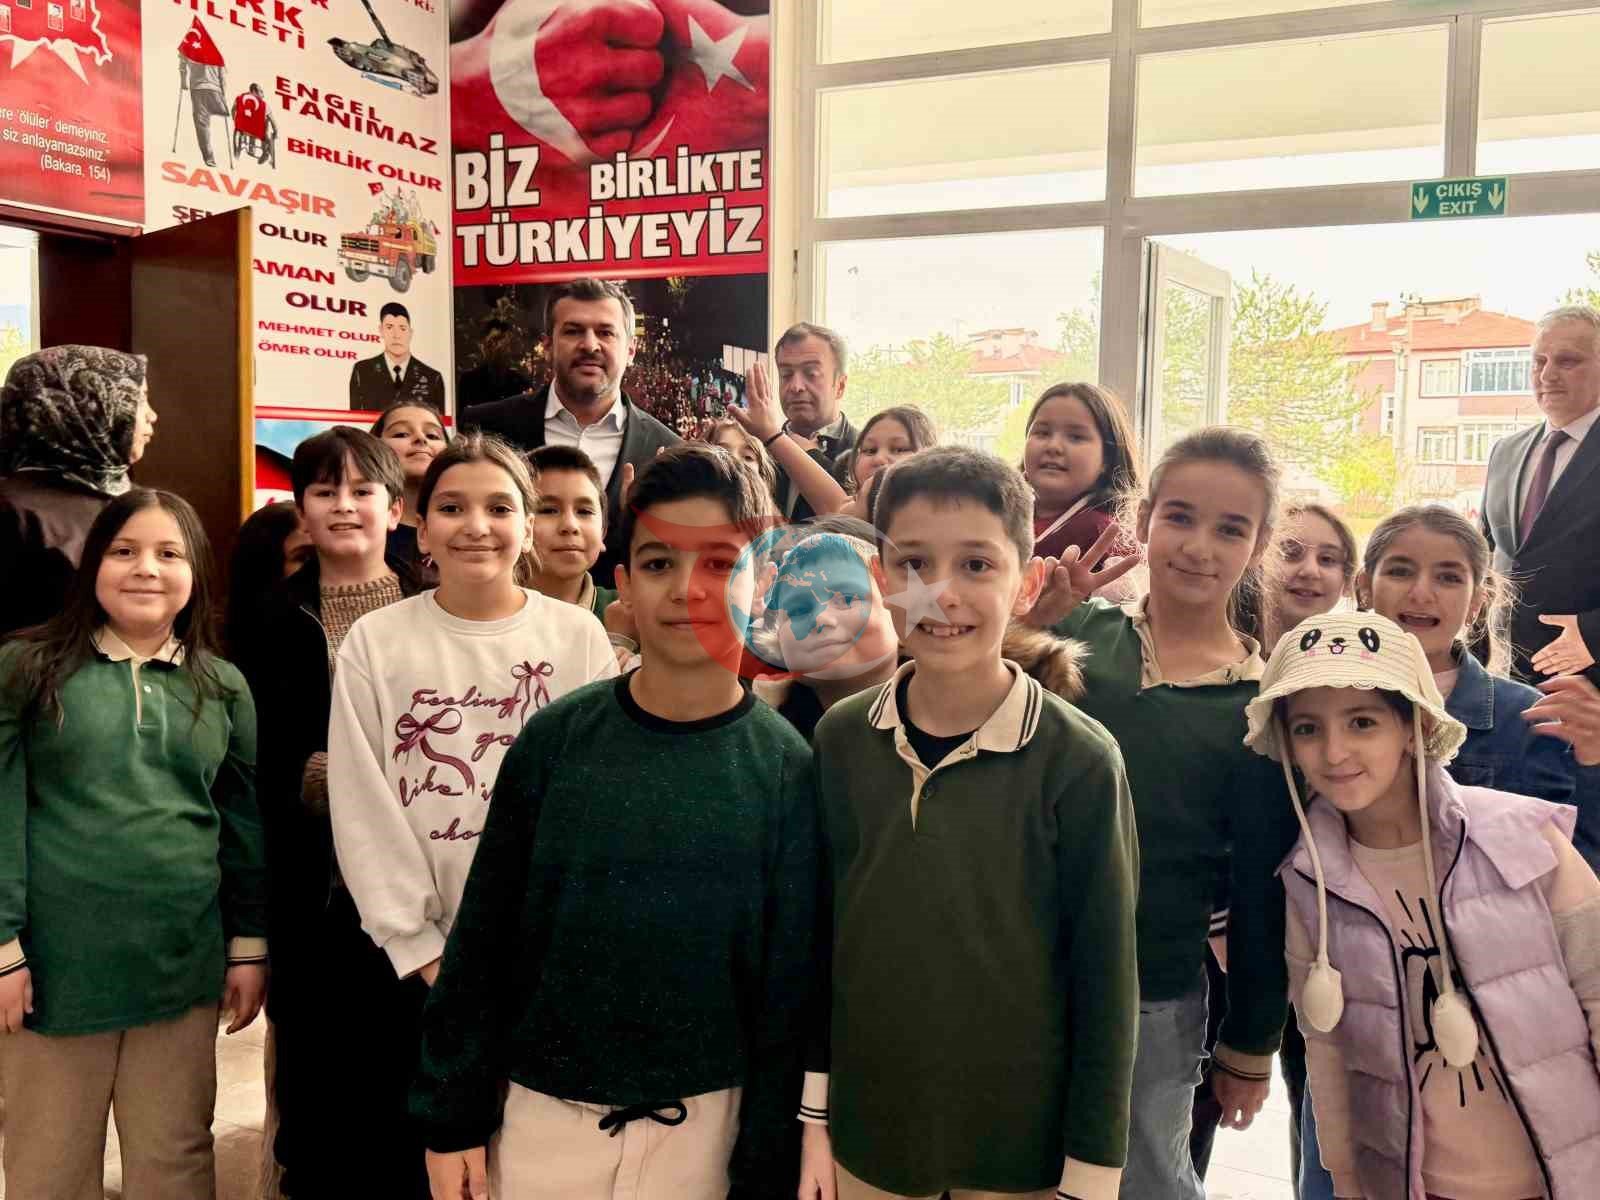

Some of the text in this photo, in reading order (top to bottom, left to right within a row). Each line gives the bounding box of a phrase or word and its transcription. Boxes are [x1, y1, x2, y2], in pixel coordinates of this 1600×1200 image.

[277, 75, 382, 122] ENGEL
[275, 90, 438, 155] TANIMAZ
[88, 164, 111, 184] 154)
[287, 137, 442, 192] BİRLİK OLUR
[454, 133, 763, 212] BİZ BİRLİKTE
[161, 161, 336, 217] SAVAŞIR
[1436, 182, 1482, 200] ÇIKIŞ
[1440, 200, 1477, 214] EXIT
[259, 223, 328, 248] OLUR
[456, 196, 764, 267] TÜRKİYEYİZ
[286, 291, 367, 317] OLUR
[258, 320, 381, 343] MEHMET OLUR
[258, 339, 358, 360] ÖMER OLUR
[410, 685, 521, 719] Feeling
[399, 765, 463, 807] like
